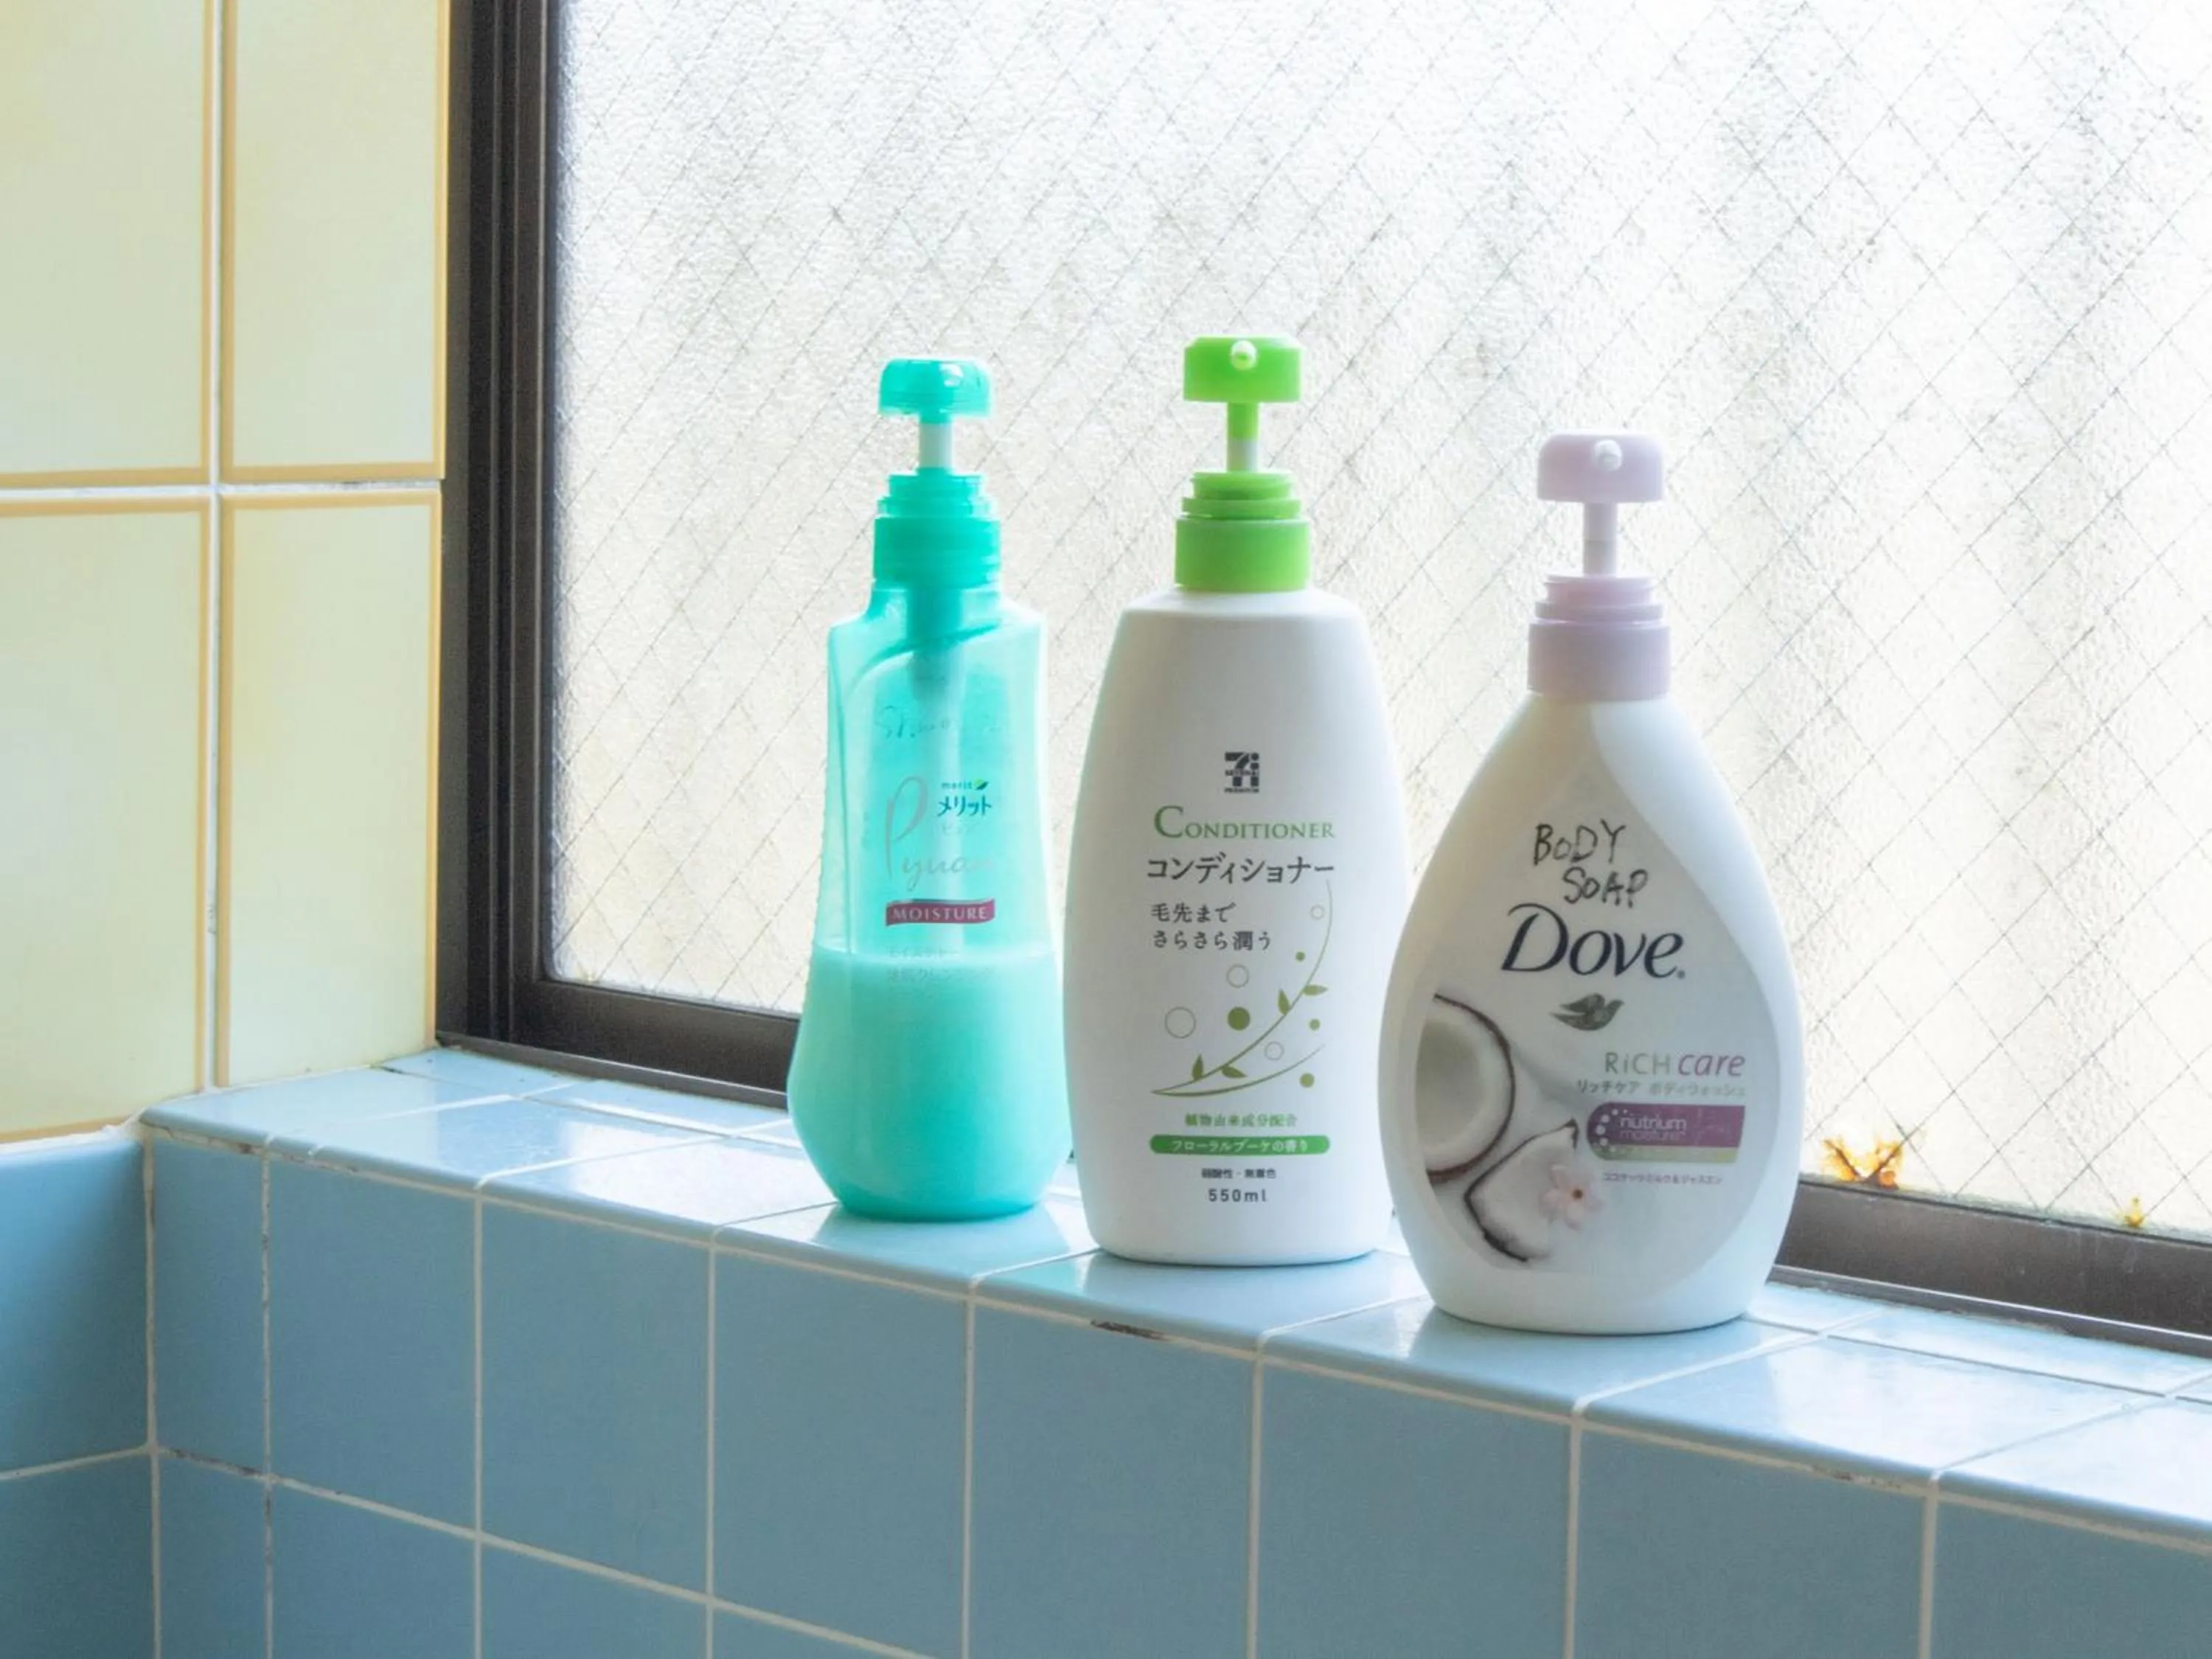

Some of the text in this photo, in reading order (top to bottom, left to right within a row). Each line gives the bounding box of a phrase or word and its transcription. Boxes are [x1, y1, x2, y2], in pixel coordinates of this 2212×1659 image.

[937, 794, 992, 816] メリット
[1154, 805, 1335, 839] CONDITIONER
[1147, 852, 1334, 884] コンディショナー
[891, 905, 988, 921] MOISTURE
[1151, 902, 1237, 923] 毛先まで
[1153, 930, 1271, 951] さらさら潤う
[1500, 902, 1684, 979] Dove
[1677, 1053, 1746, 1077] care
[1577, 1079, 1641, 1094] リッチケア
[1172, 1138, 1308, 1153] フローラルブーケの香り
[1208, 1188, 1267, 1203] 550ml
